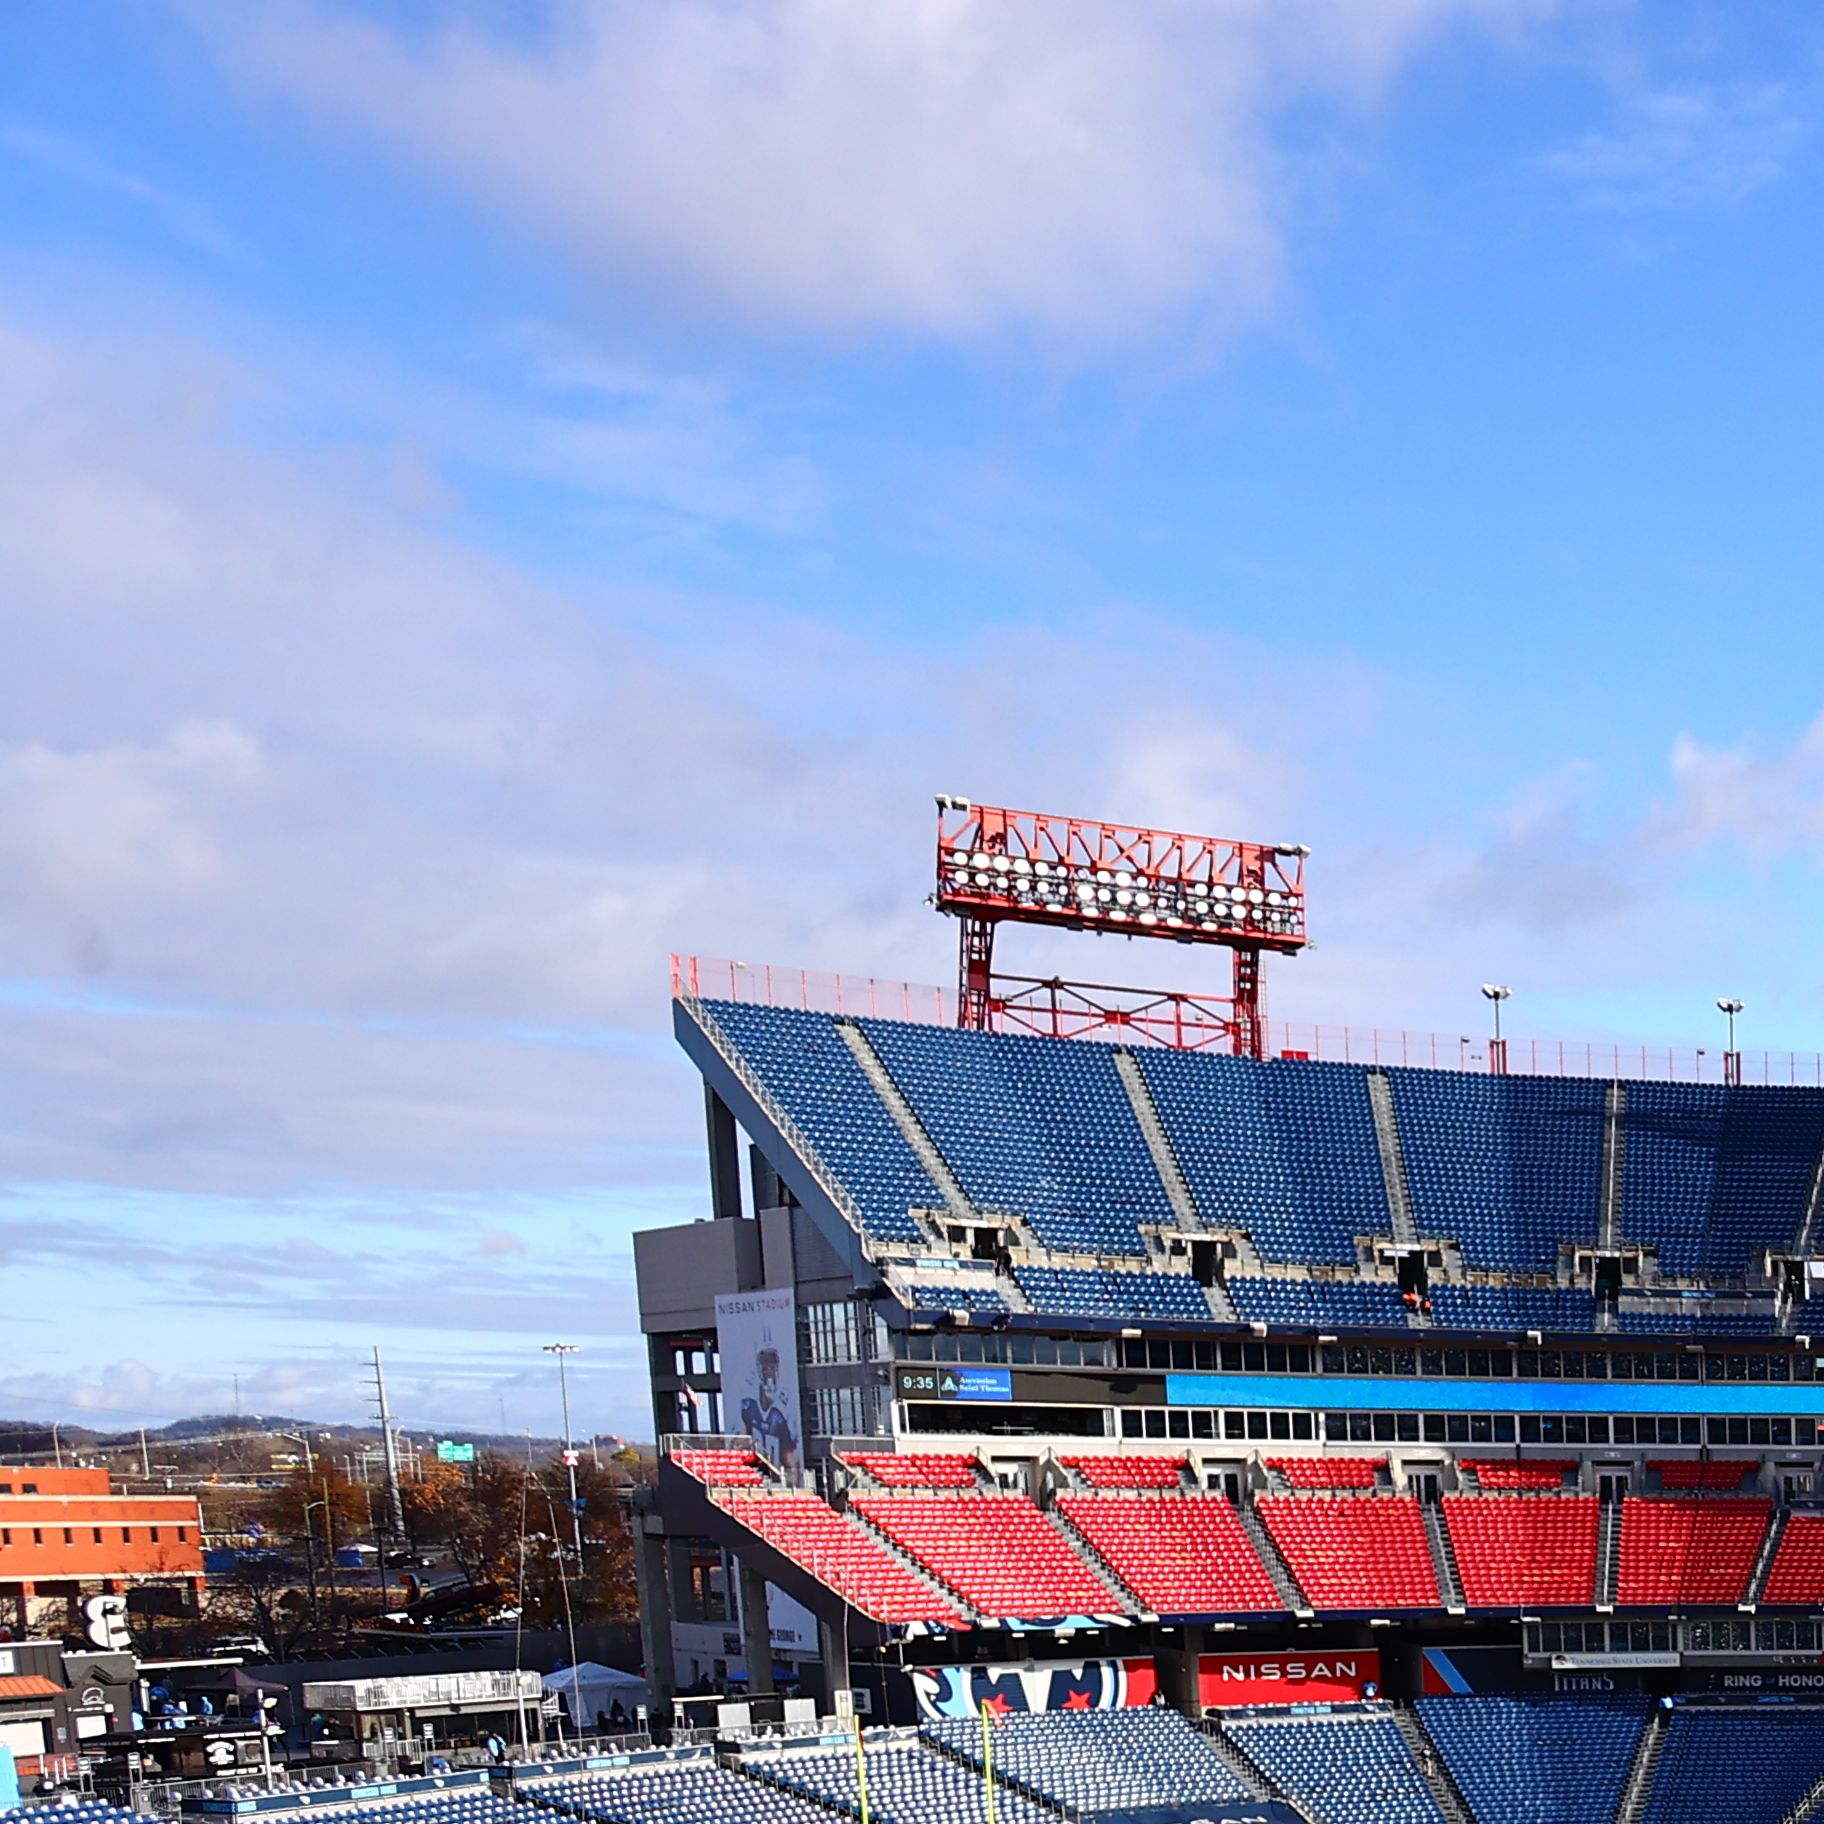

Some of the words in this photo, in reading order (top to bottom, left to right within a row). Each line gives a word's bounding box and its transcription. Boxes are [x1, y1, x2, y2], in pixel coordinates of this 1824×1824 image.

[718, 1300, 755, 1316] NISSAN
[903, 1376, 934, 1390] 9:35
[1222, 1661, 1357, 1682] NISSAN
[1553, 1670, 1616, 1691] TITANS
[1724, 1675, 1762, 1688] RING
